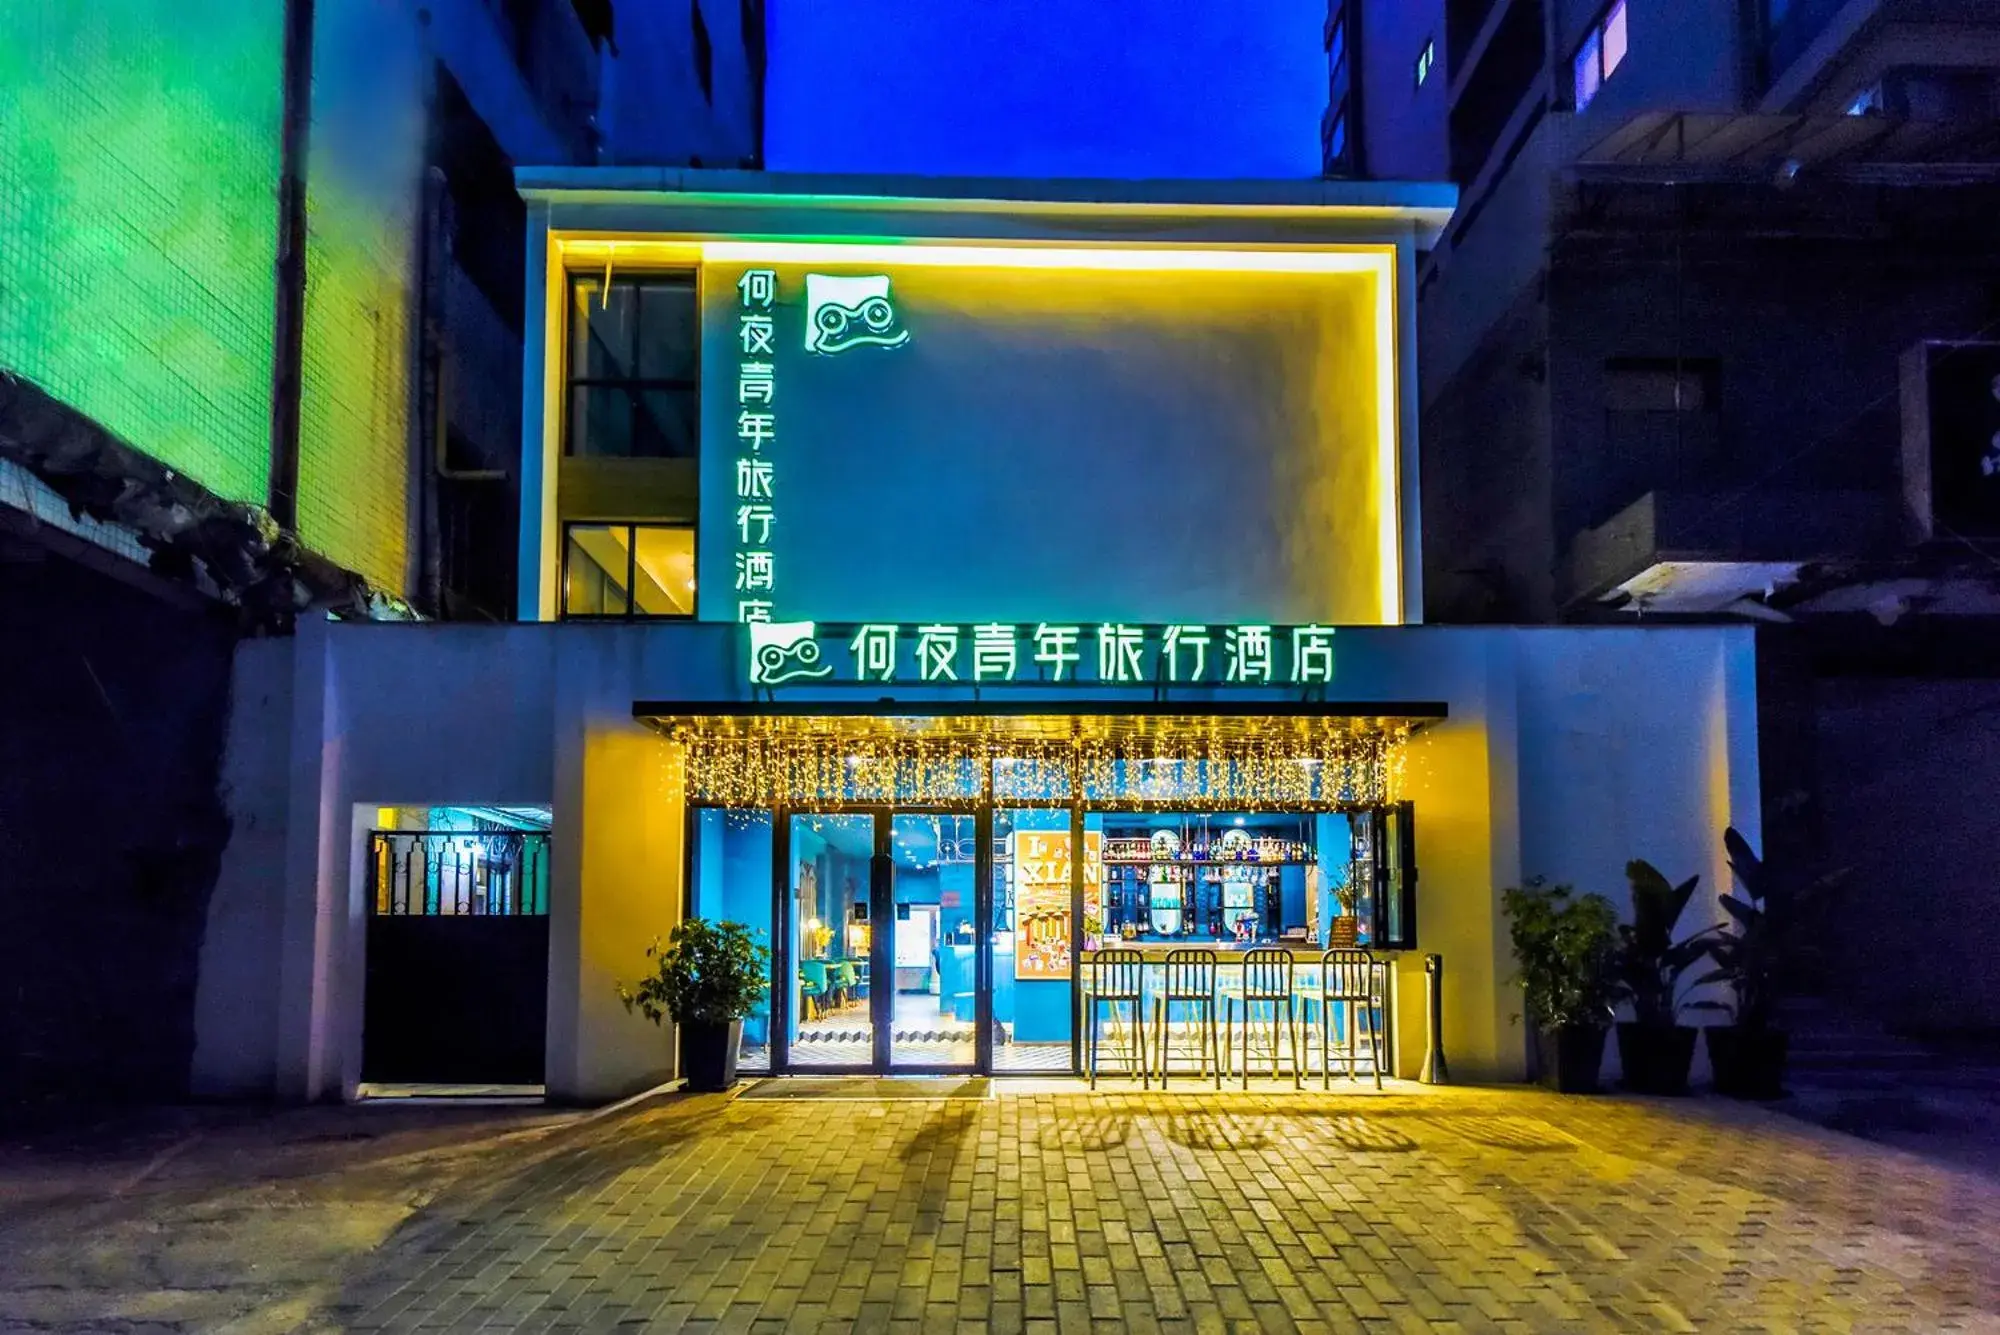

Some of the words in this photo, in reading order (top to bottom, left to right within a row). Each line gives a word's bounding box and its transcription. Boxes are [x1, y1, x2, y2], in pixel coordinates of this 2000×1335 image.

[850, 623, 1335, 683] 何夜青年旅行酒店
